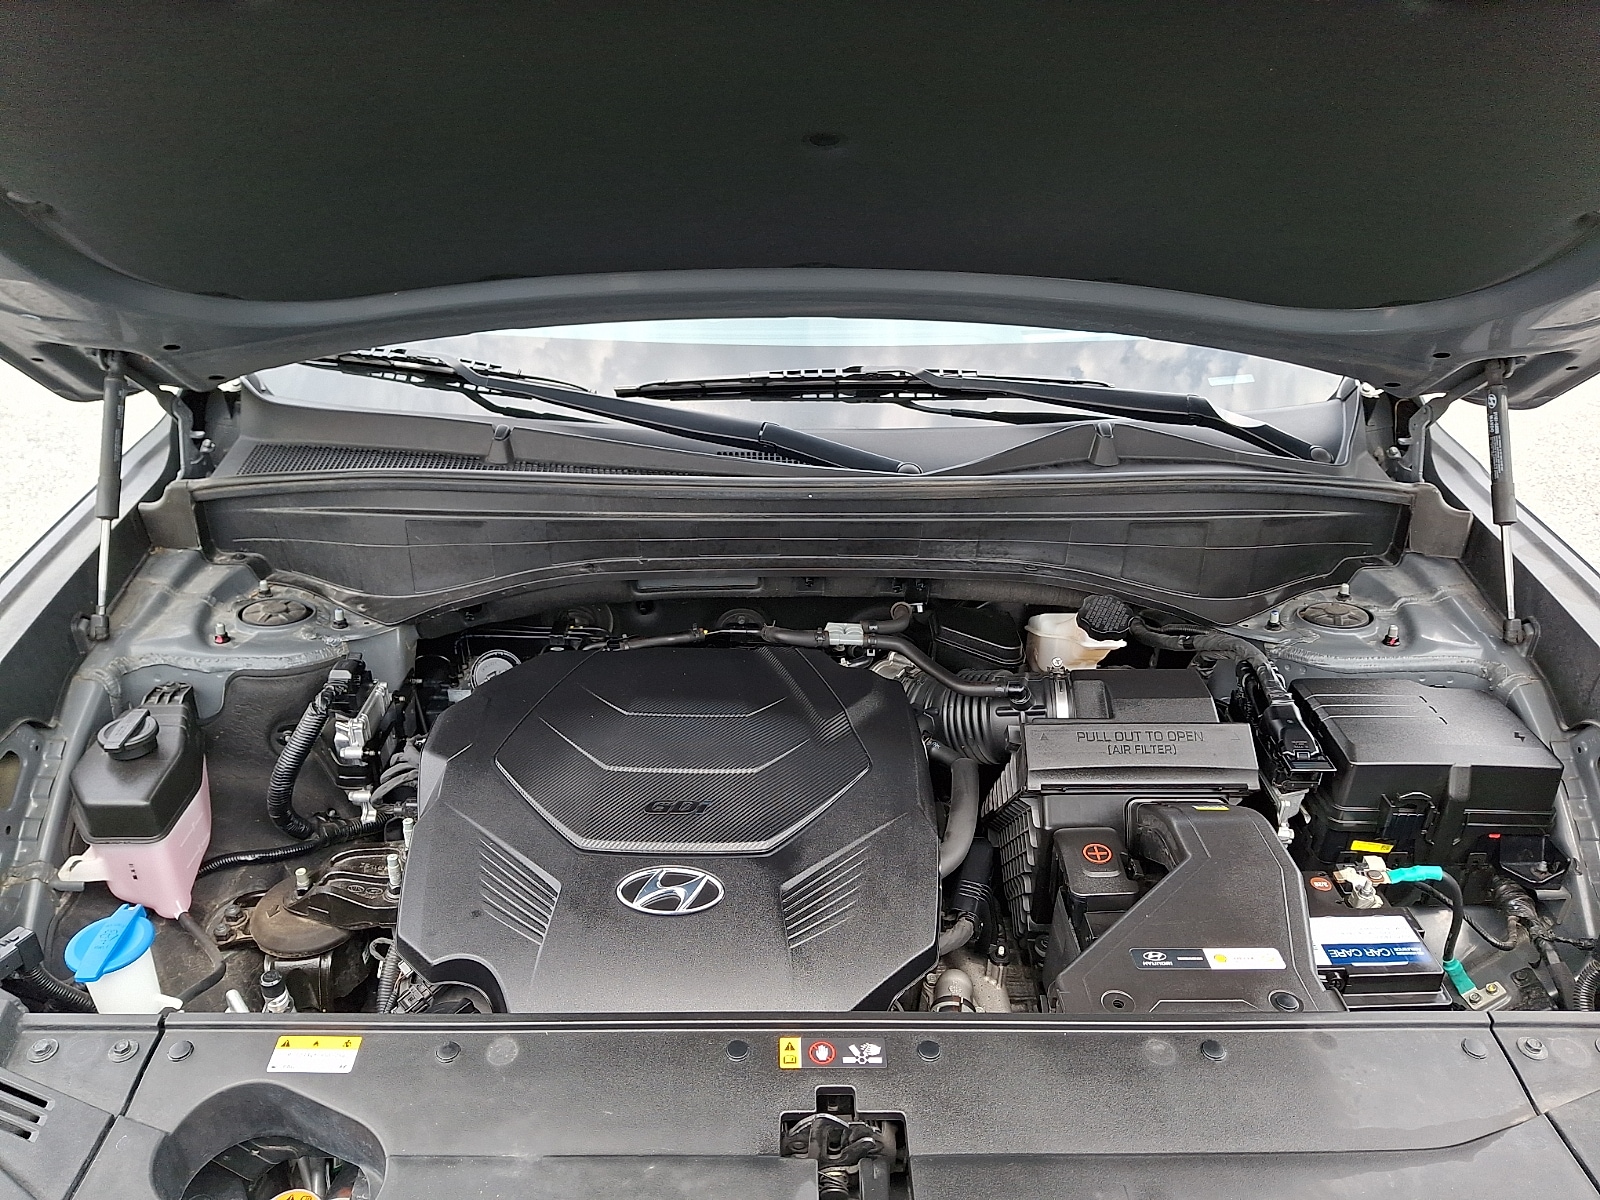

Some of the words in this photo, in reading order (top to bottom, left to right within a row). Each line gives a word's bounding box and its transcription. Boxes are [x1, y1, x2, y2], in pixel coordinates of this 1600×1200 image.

[1076, 731, 1112, 742] PULL
[1114, 731, 1141, 742] OUT
[1145, 731, 1164, 742] TO
[1167, 731, 1204, 742] OPEN
[1328, 948, 1363, 958] CARE
[1363, 948, 1391, 957] CAR
